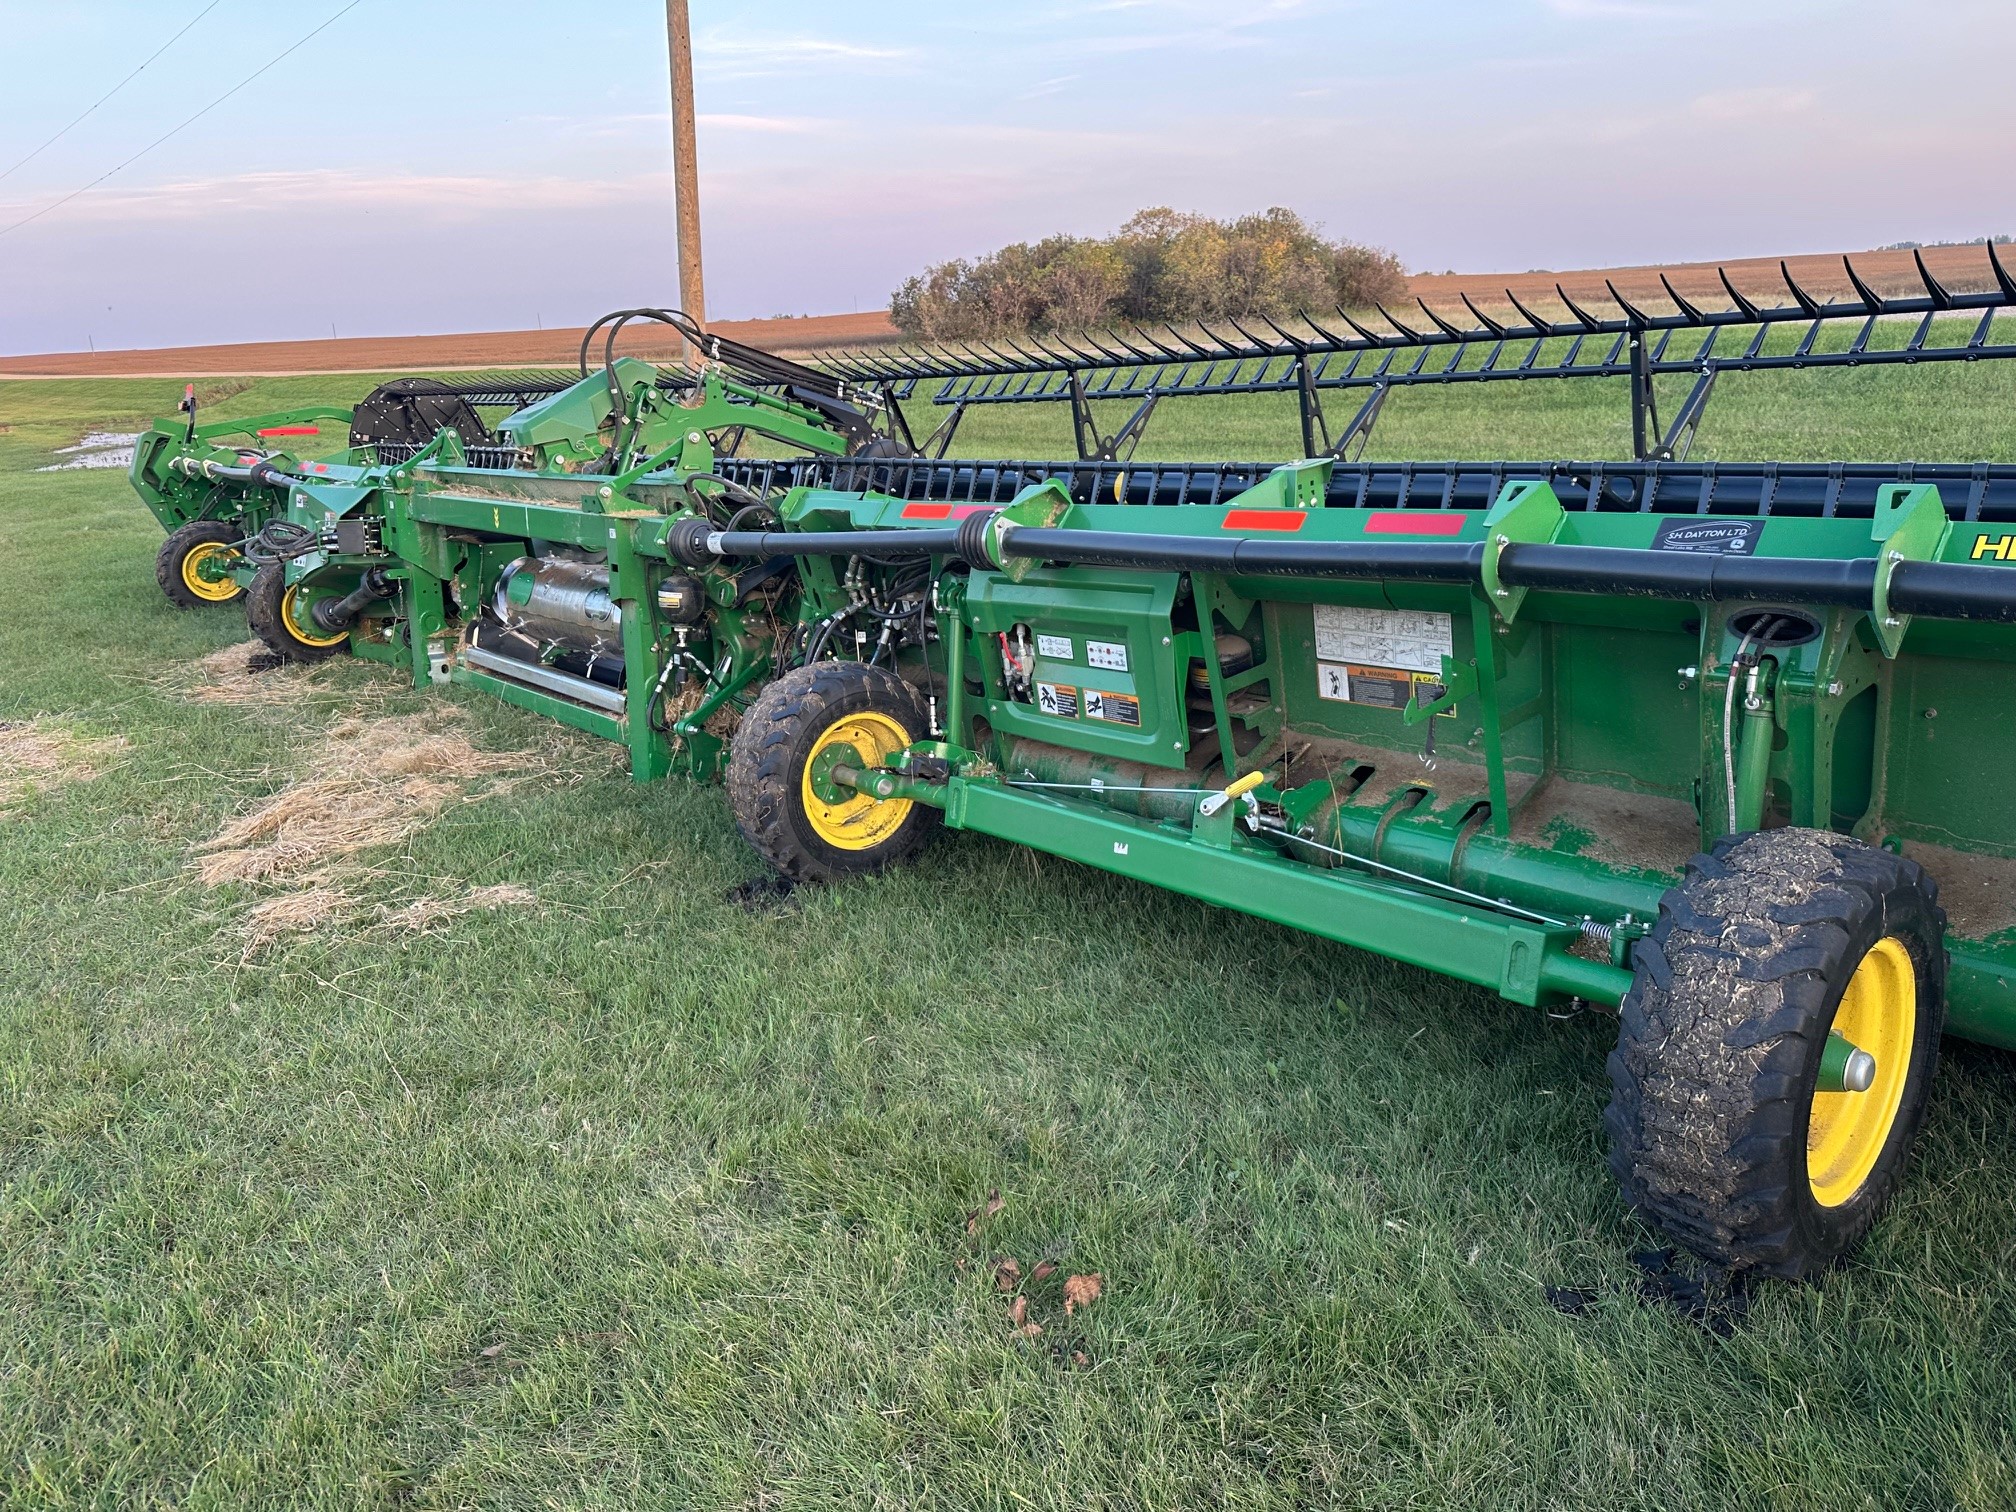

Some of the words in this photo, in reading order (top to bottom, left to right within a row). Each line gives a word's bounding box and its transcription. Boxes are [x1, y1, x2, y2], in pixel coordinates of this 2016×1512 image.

[1684, 530, 1726, 539] DAYTON
[1727, 528, 1748, 536] LTD.
[1969, 534, 2016, 560] H
[1367, 670, 1398, 679] WARNING
